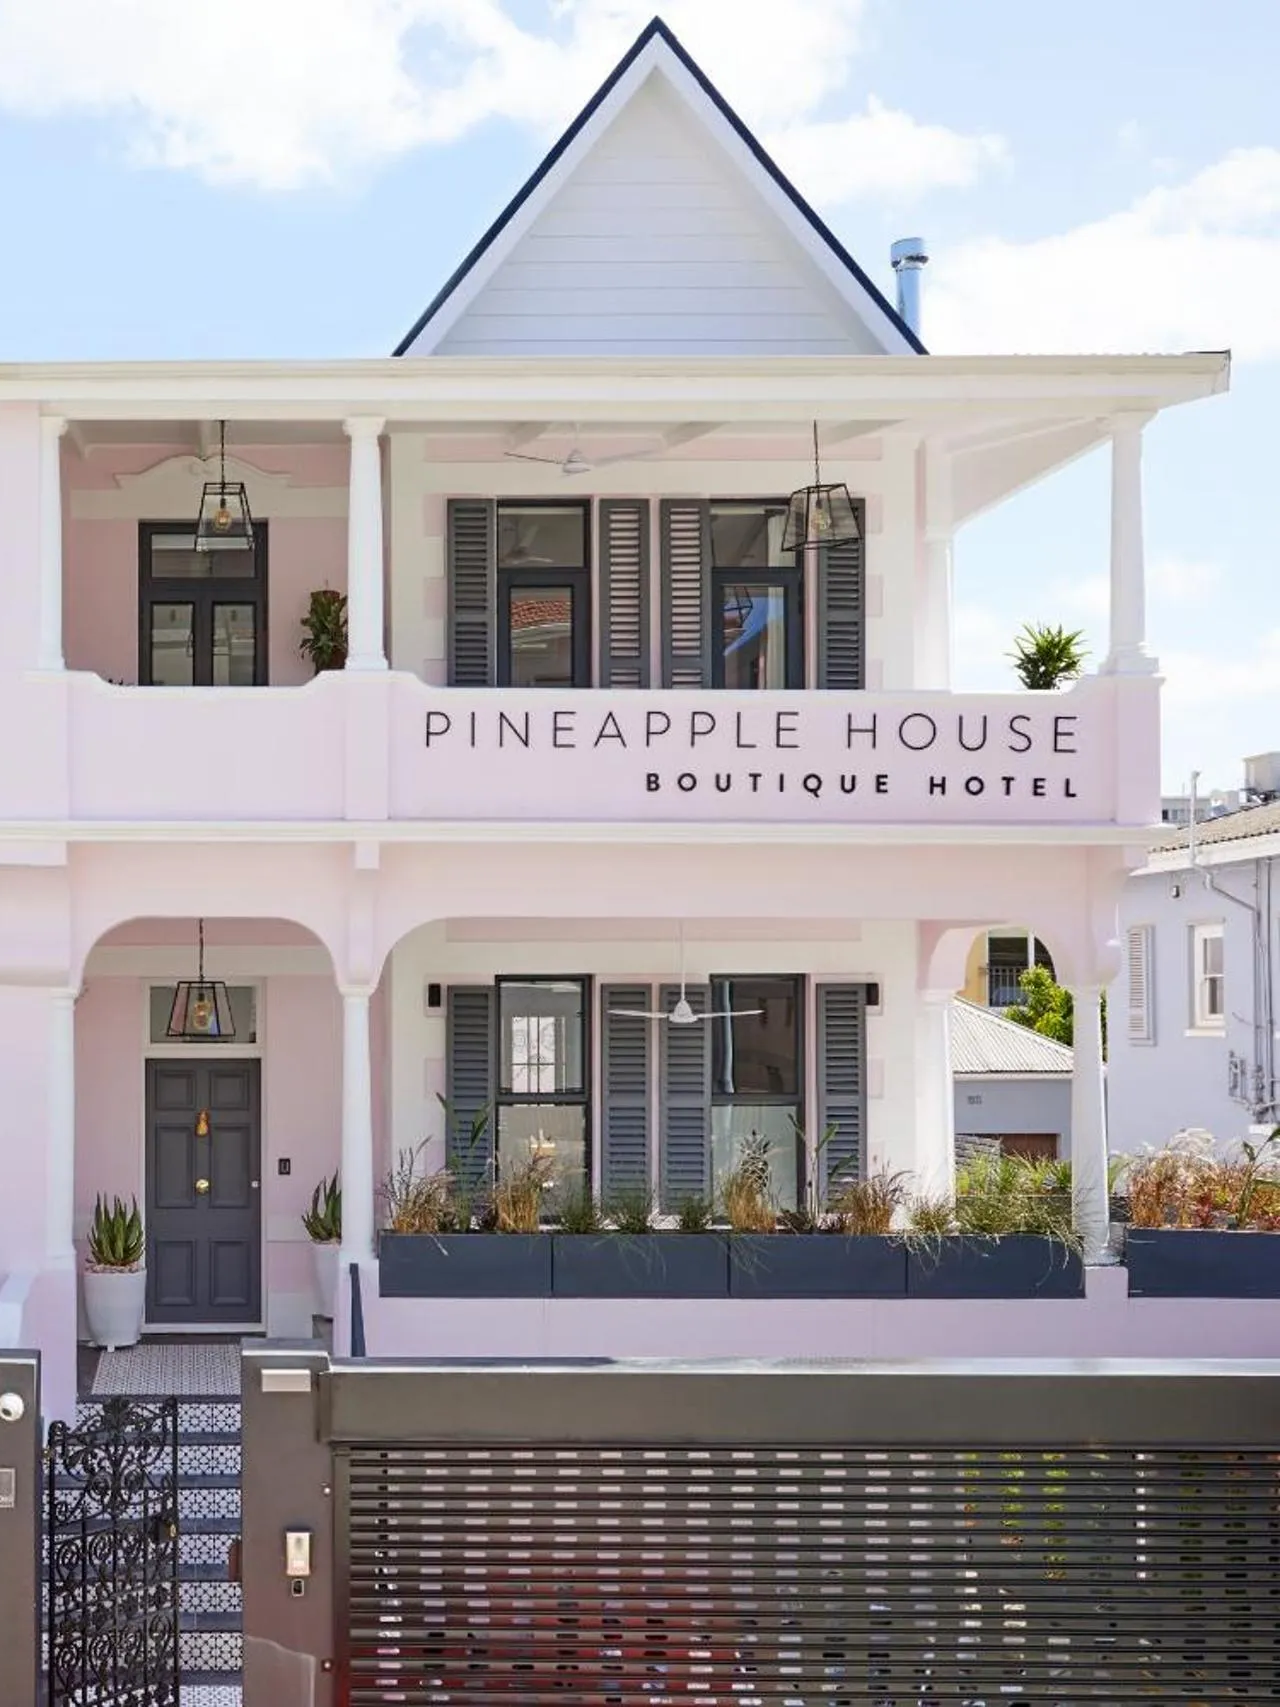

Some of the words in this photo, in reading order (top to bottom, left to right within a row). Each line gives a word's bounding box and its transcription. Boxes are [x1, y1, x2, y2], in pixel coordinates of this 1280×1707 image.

[424, 710, 801, 749] PINEAPPLE
[846, 712, 1079, 754] HOUSE
[645, 772, 890, 799] BOUTIQUE
[928, 774, 1078, 799] HOTEL
